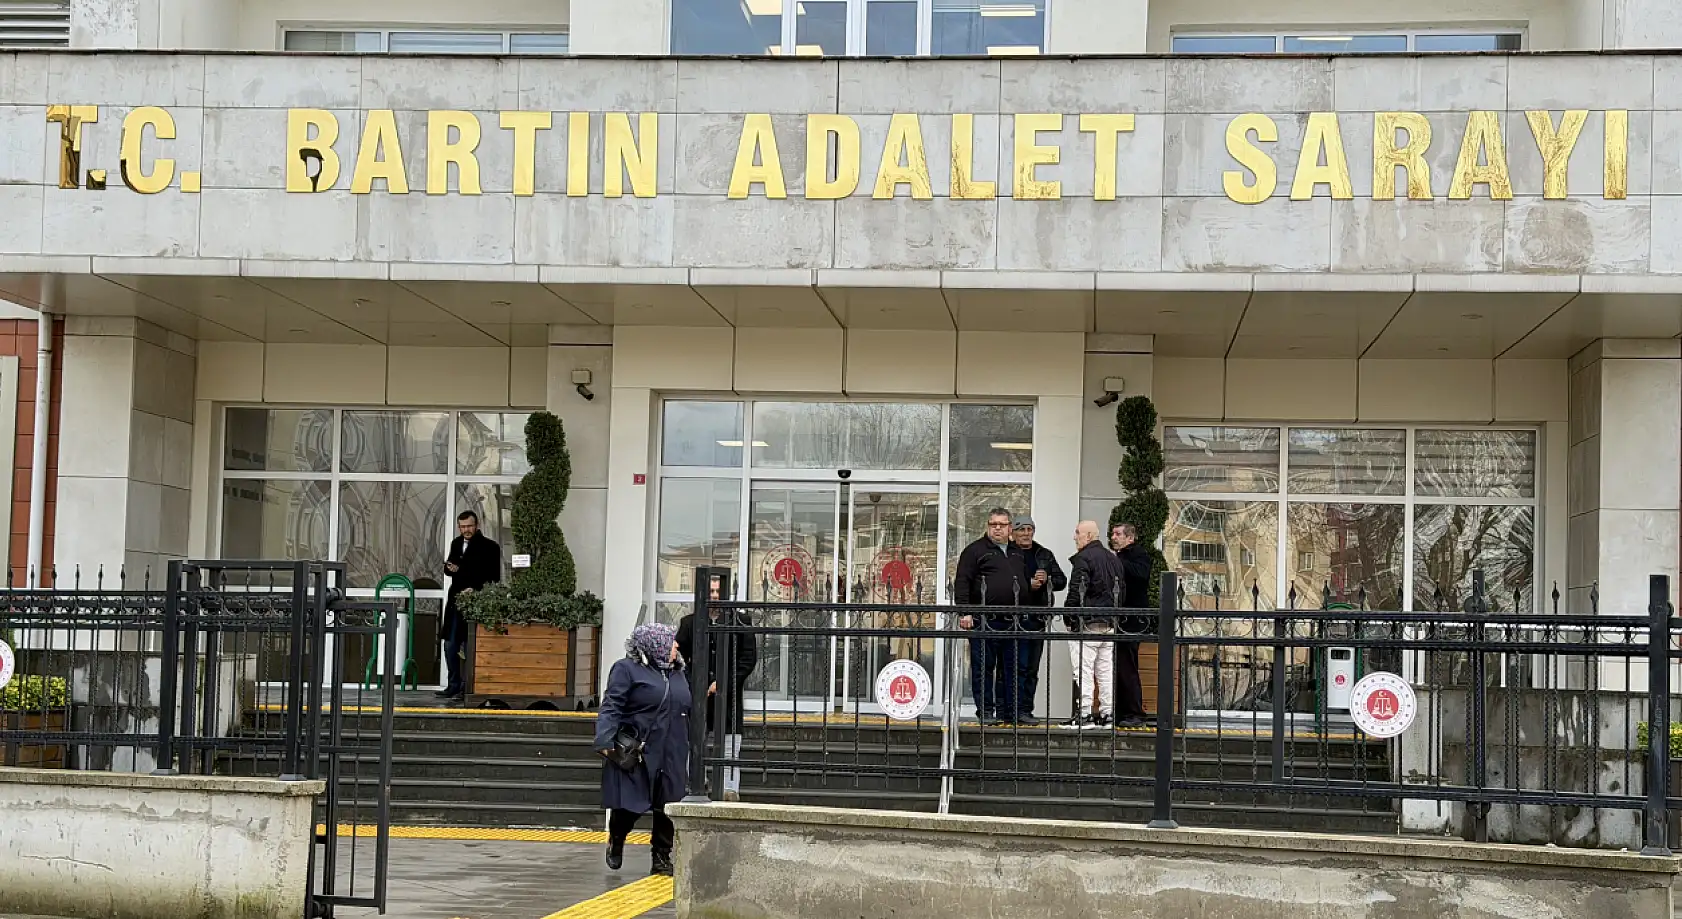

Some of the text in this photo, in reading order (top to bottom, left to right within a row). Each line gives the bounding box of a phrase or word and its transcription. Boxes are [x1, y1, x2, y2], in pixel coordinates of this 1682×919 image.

[46, 104, 1628, 205] T.C. BARTIN ADALET SARAYI
